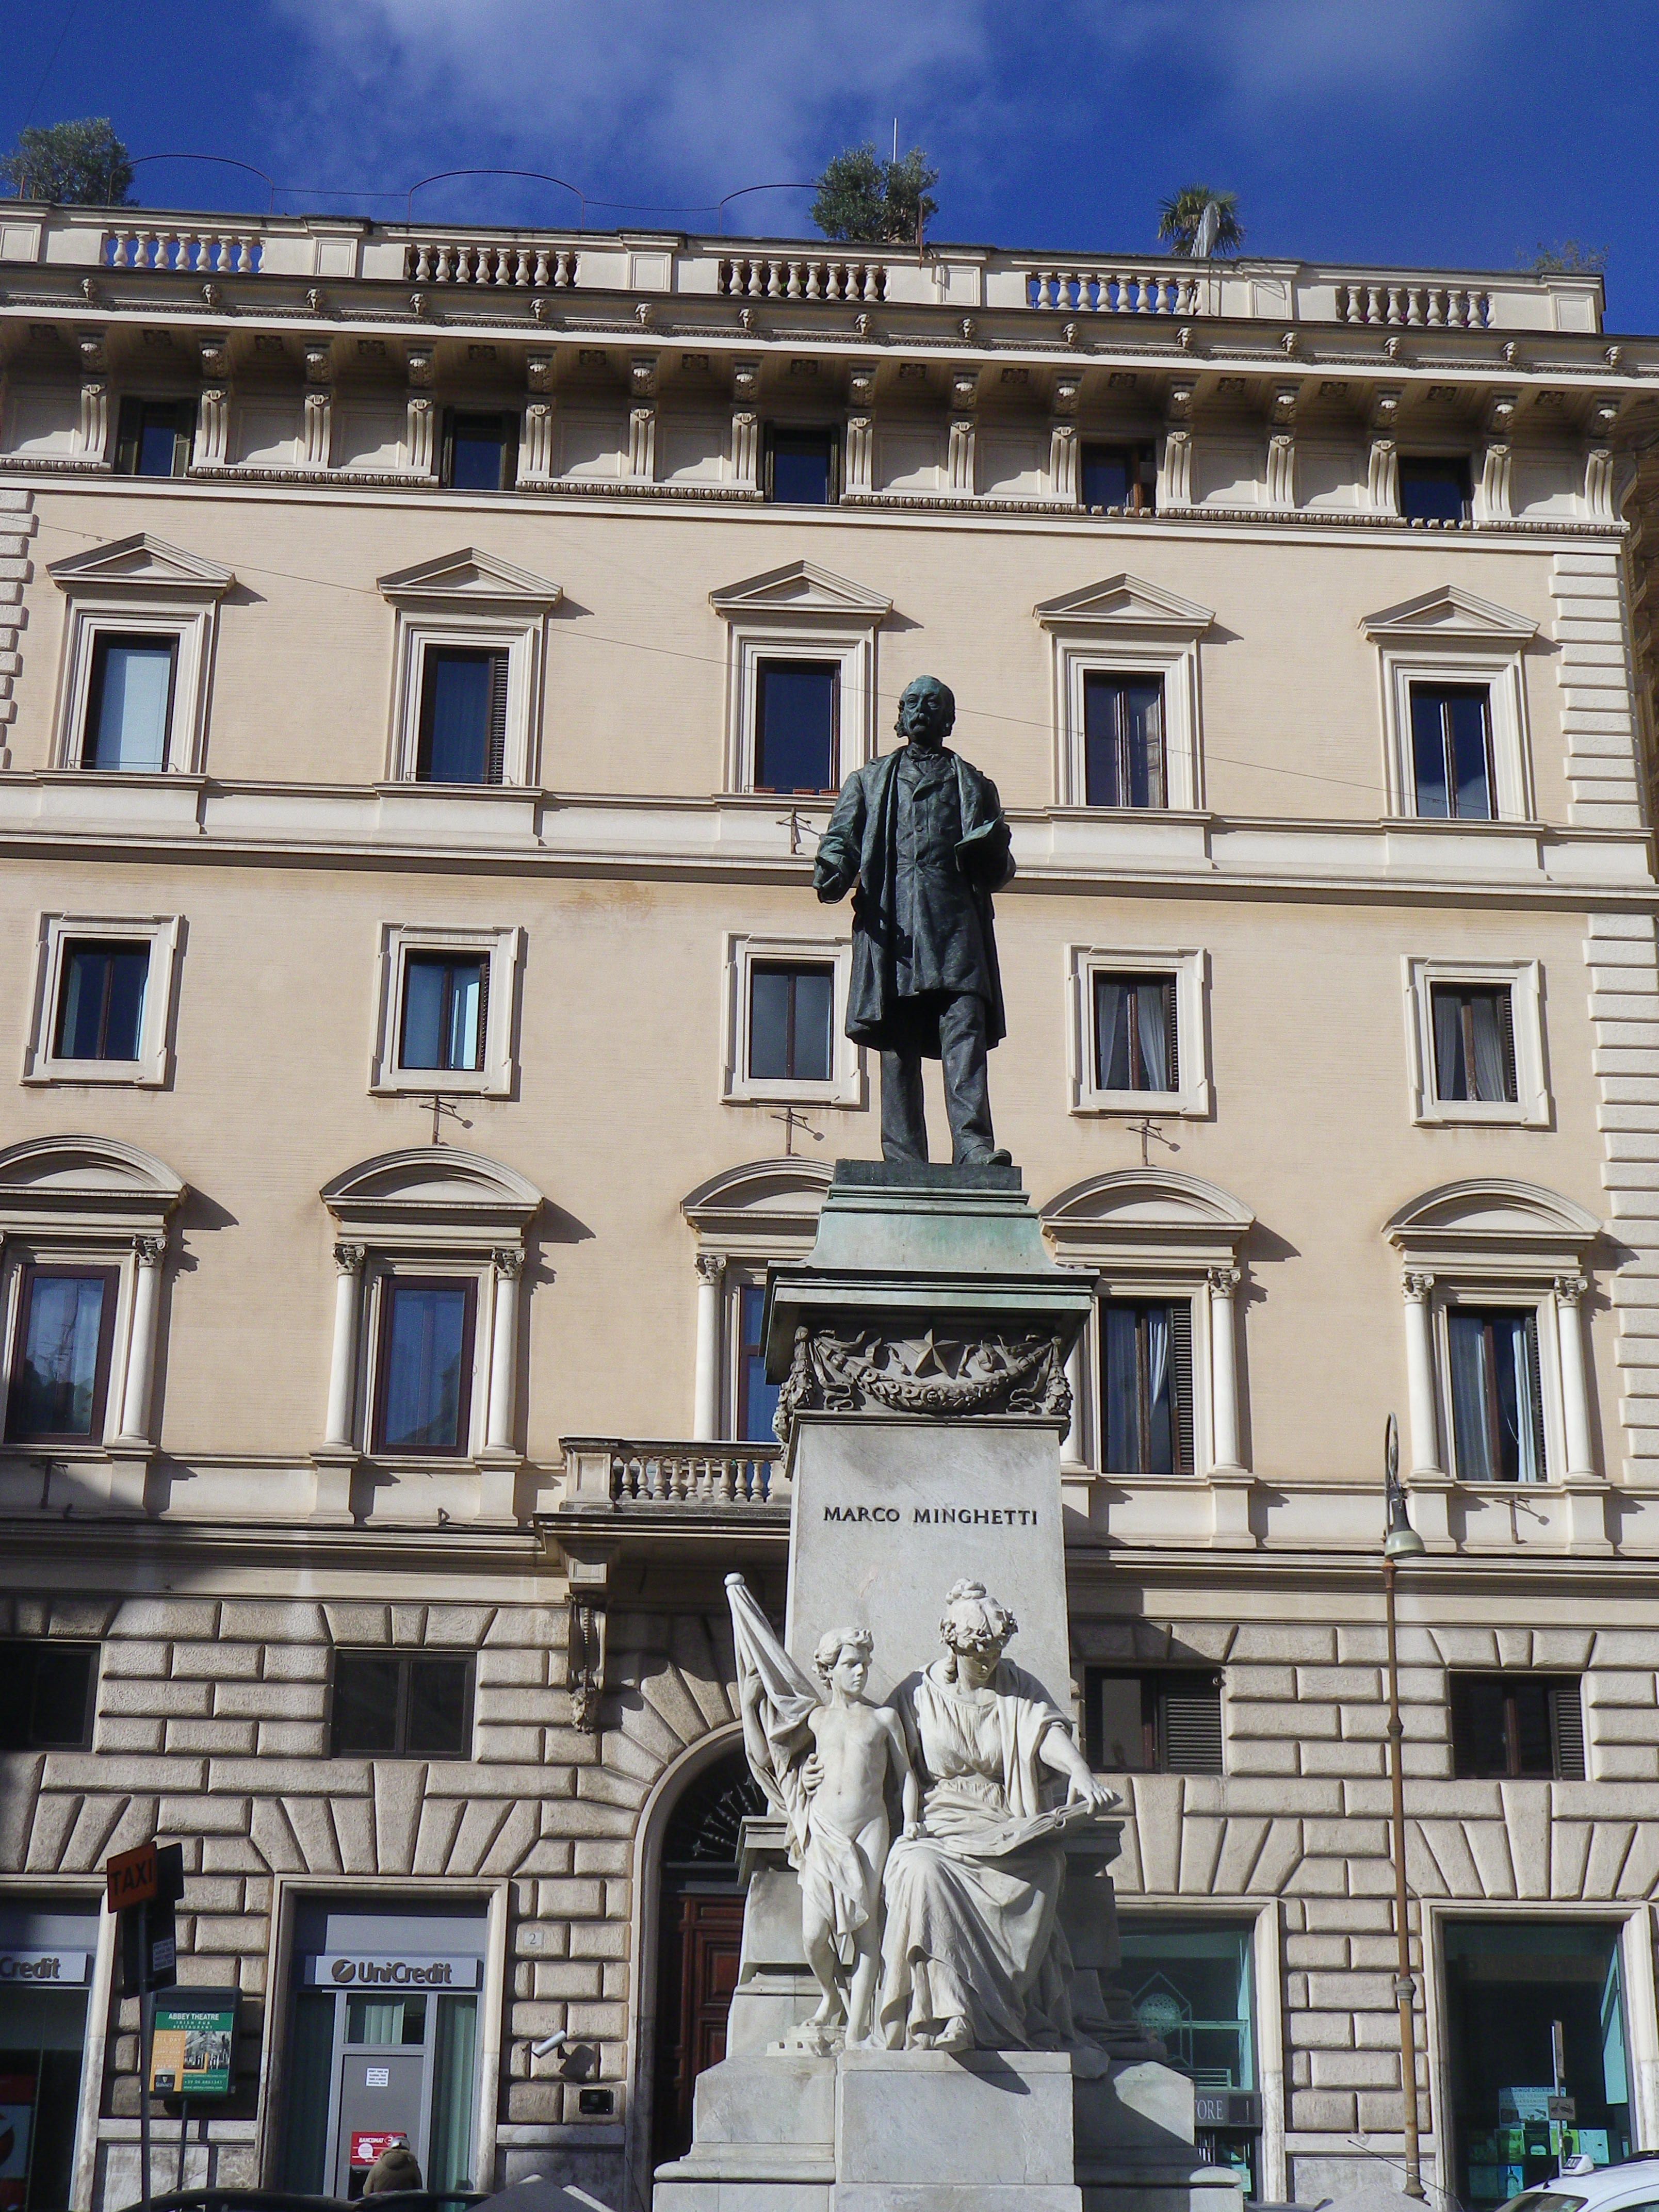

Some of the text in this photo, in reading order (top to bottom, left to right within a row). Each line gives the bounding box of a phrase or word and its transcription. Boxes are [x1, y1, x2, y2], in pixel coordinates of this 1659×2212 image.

[823, 1506, 1037, 1525] MARCO MINGHETTI
[111, 1858, 154, 1896] TAXI
[358, 1961, 452, 1983] UniCredit
[1195, 2099, 1224, 2120] ORE
